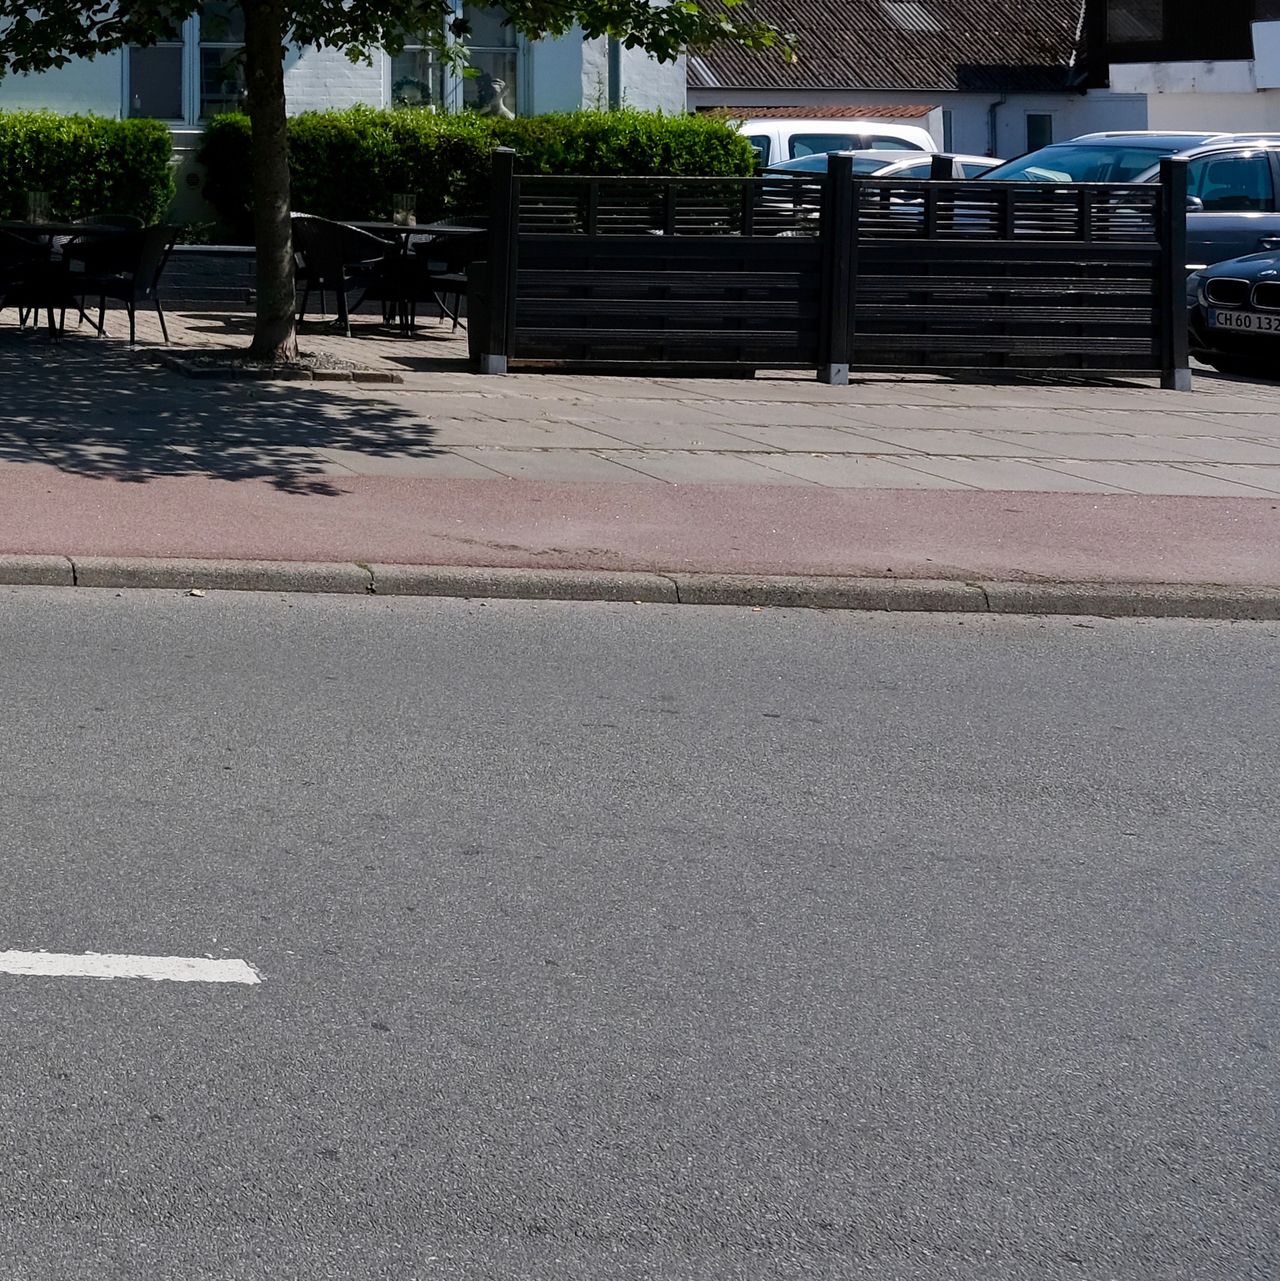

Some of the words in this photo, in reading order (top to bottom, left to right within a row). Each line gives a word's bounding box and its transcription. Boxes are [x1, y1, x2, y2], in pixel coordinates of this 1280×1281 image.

[1217, 312, 1233, 326] CH
[1235, 314, 1252, 329] 60
[1256, 316, 1280, 332] 132
